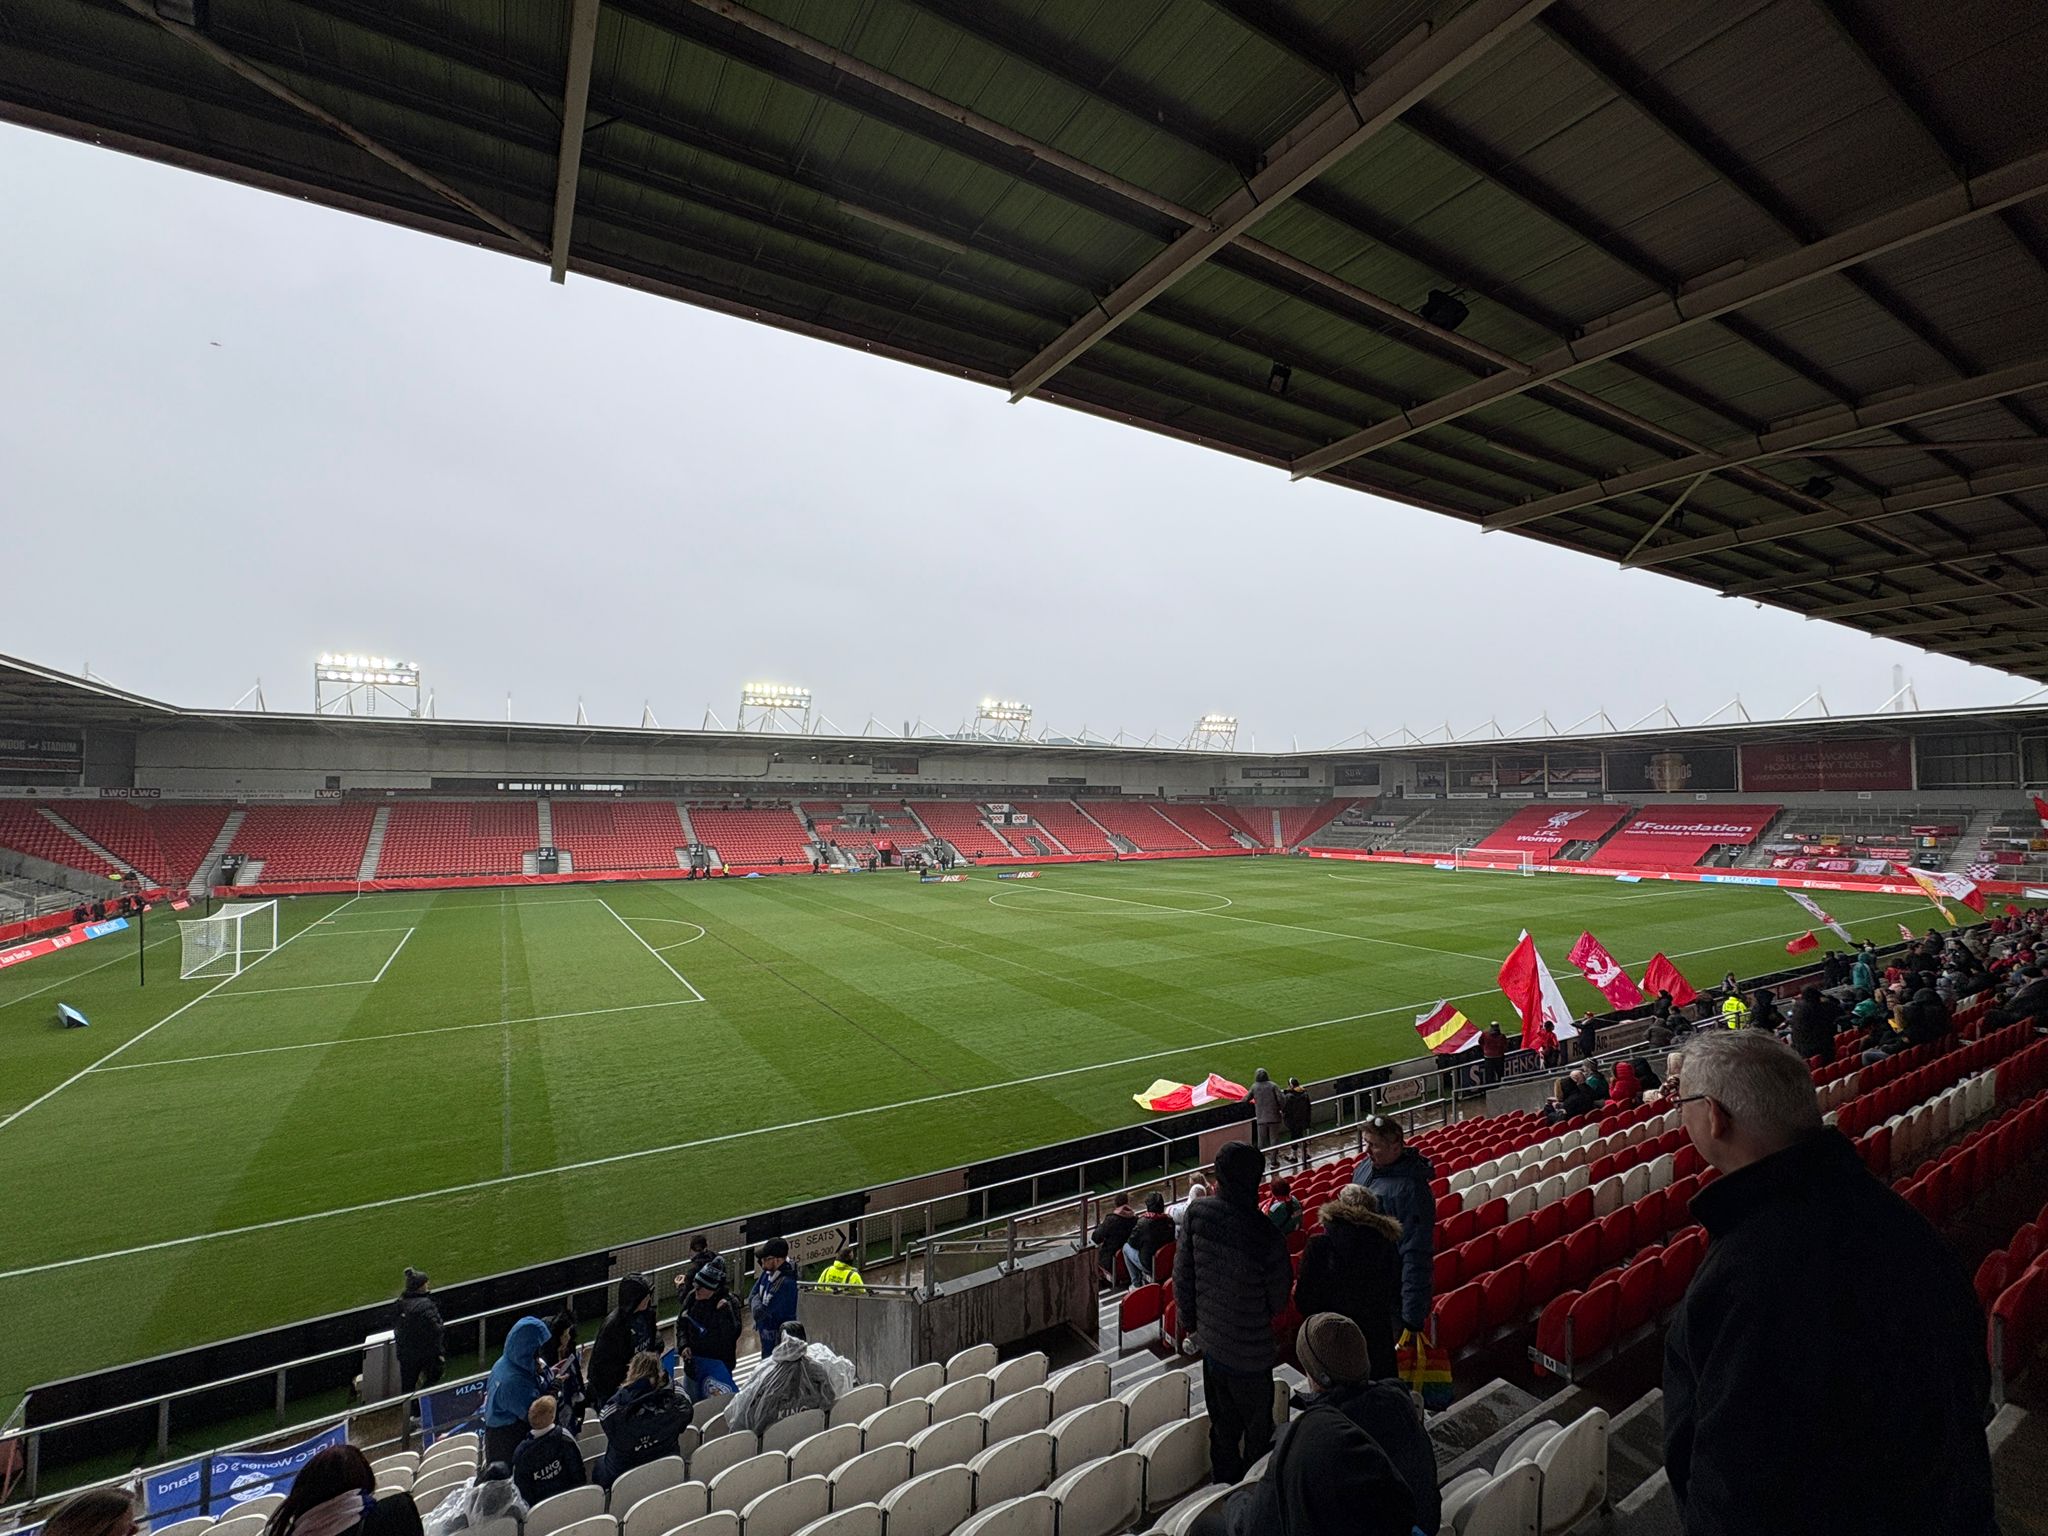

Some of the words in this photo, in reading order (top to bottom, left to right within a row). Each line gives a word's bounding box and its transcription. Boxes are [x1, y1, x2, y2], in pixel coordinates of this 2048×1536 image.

[41, 740, 77, 752] STADIUM
[1837, 760, 1883, 769] TICKETS
[101, 788, 128, 797] LWC
[131, 788, 160, 797] LWC
[315, 790, 341, 798] LWC
[1642, 822, 1752, 832] Foundation
[1517, 835, 1563, 843] Women
[806, 1230, 835, 1246] SEATS
[1545, 1357, 1554, 1370] M
[533, 1459, 560, 1481] KING
